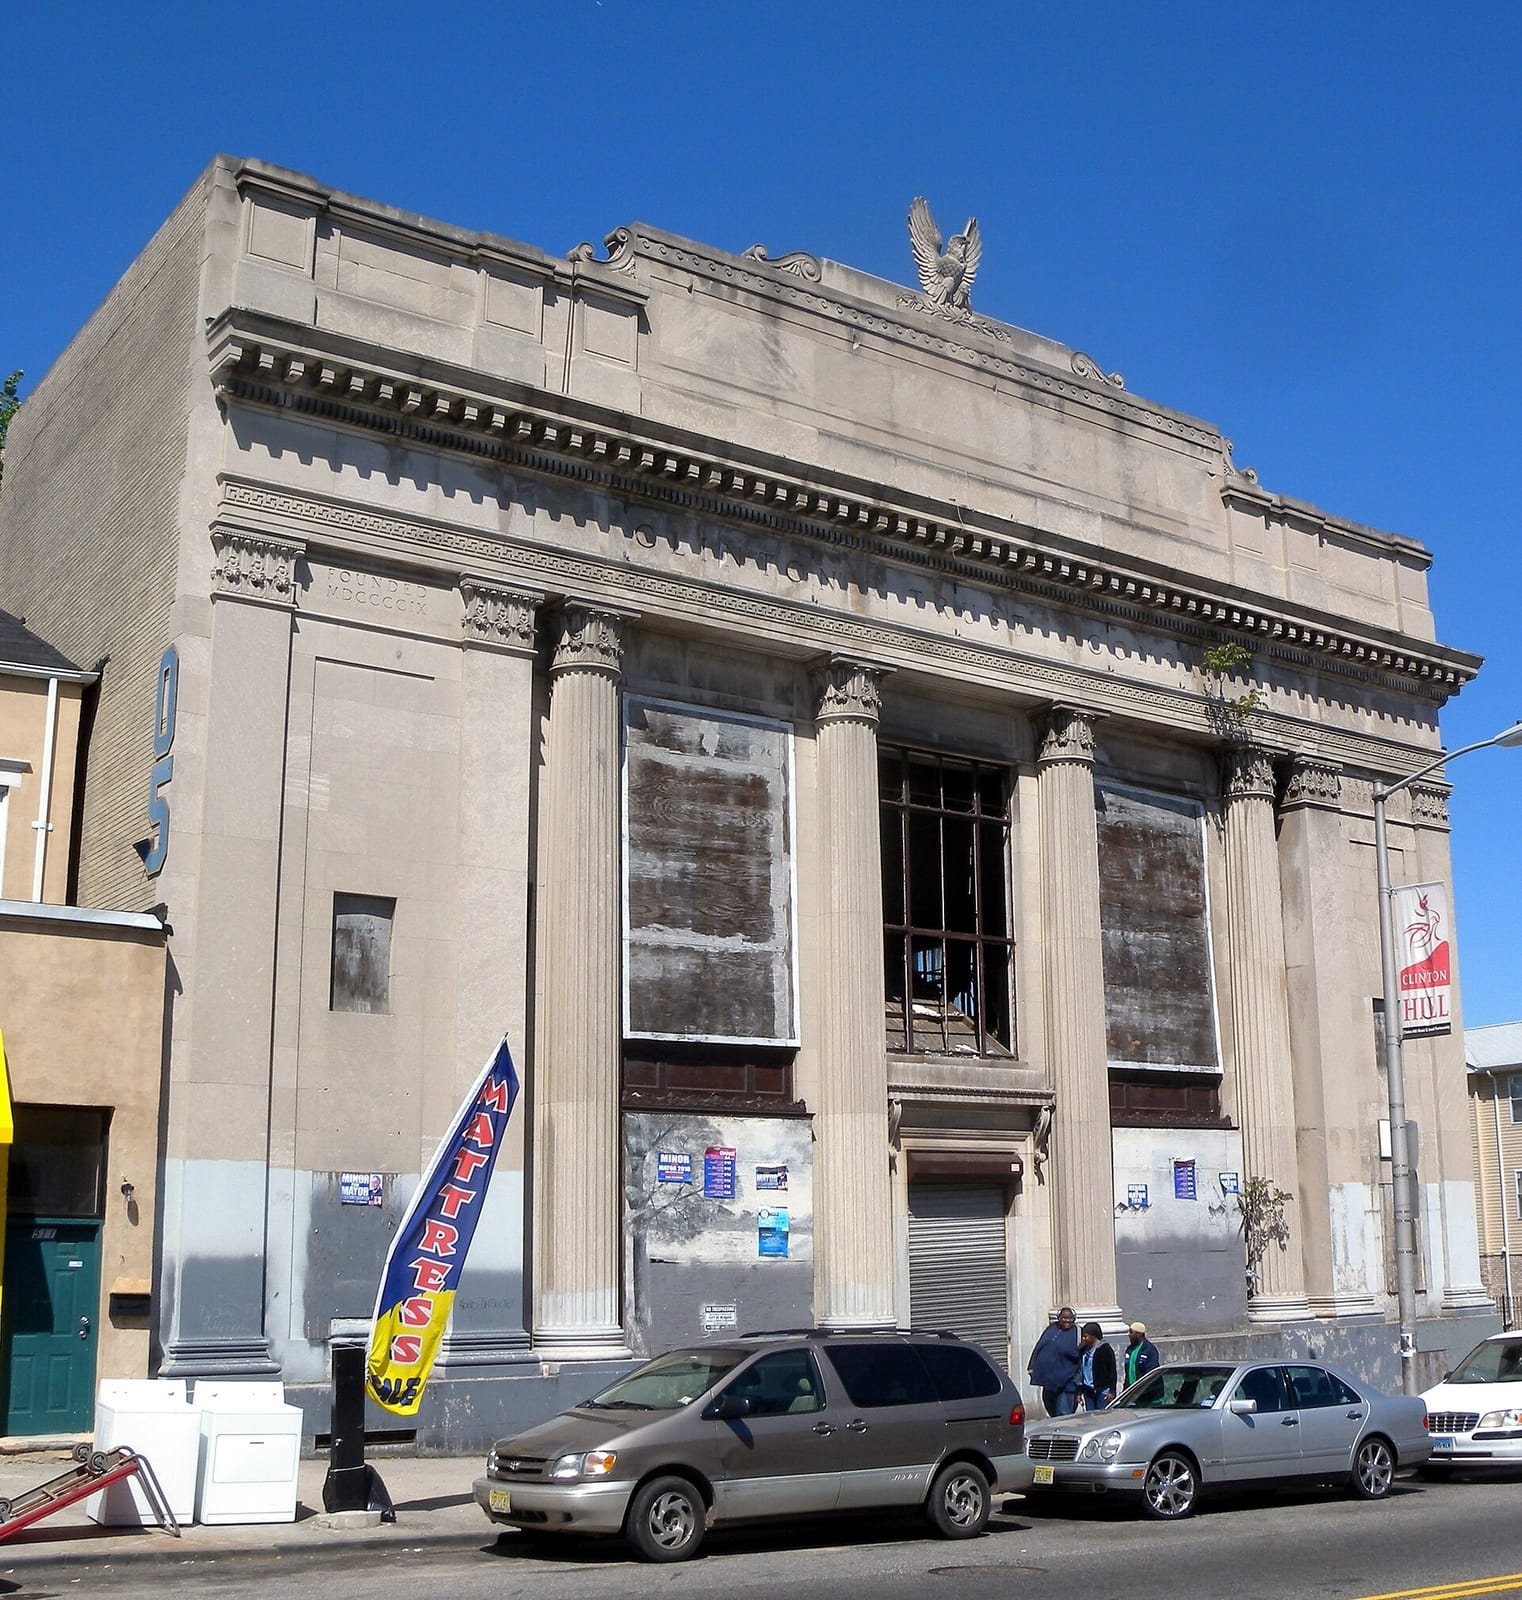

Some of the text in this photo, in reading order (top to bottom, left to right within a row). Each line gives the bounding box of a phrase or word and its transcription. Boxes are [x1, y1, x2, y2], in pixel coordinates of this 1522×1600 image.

[327, 567, 427, 598] FOUNDED
[326, 585, 427, 615] MDCCCCIX
[1402, 970, 1447, 985] CLINTON
[1403, 995, 1449, 1021] HILL
[660, 1154, 690, 1164] MINOR
[341, 1173, 370, 1184] MINOR
[341, 1186, 369, 1196] MAYOR
[391, 1075, 509, 1365] MATTRESS
